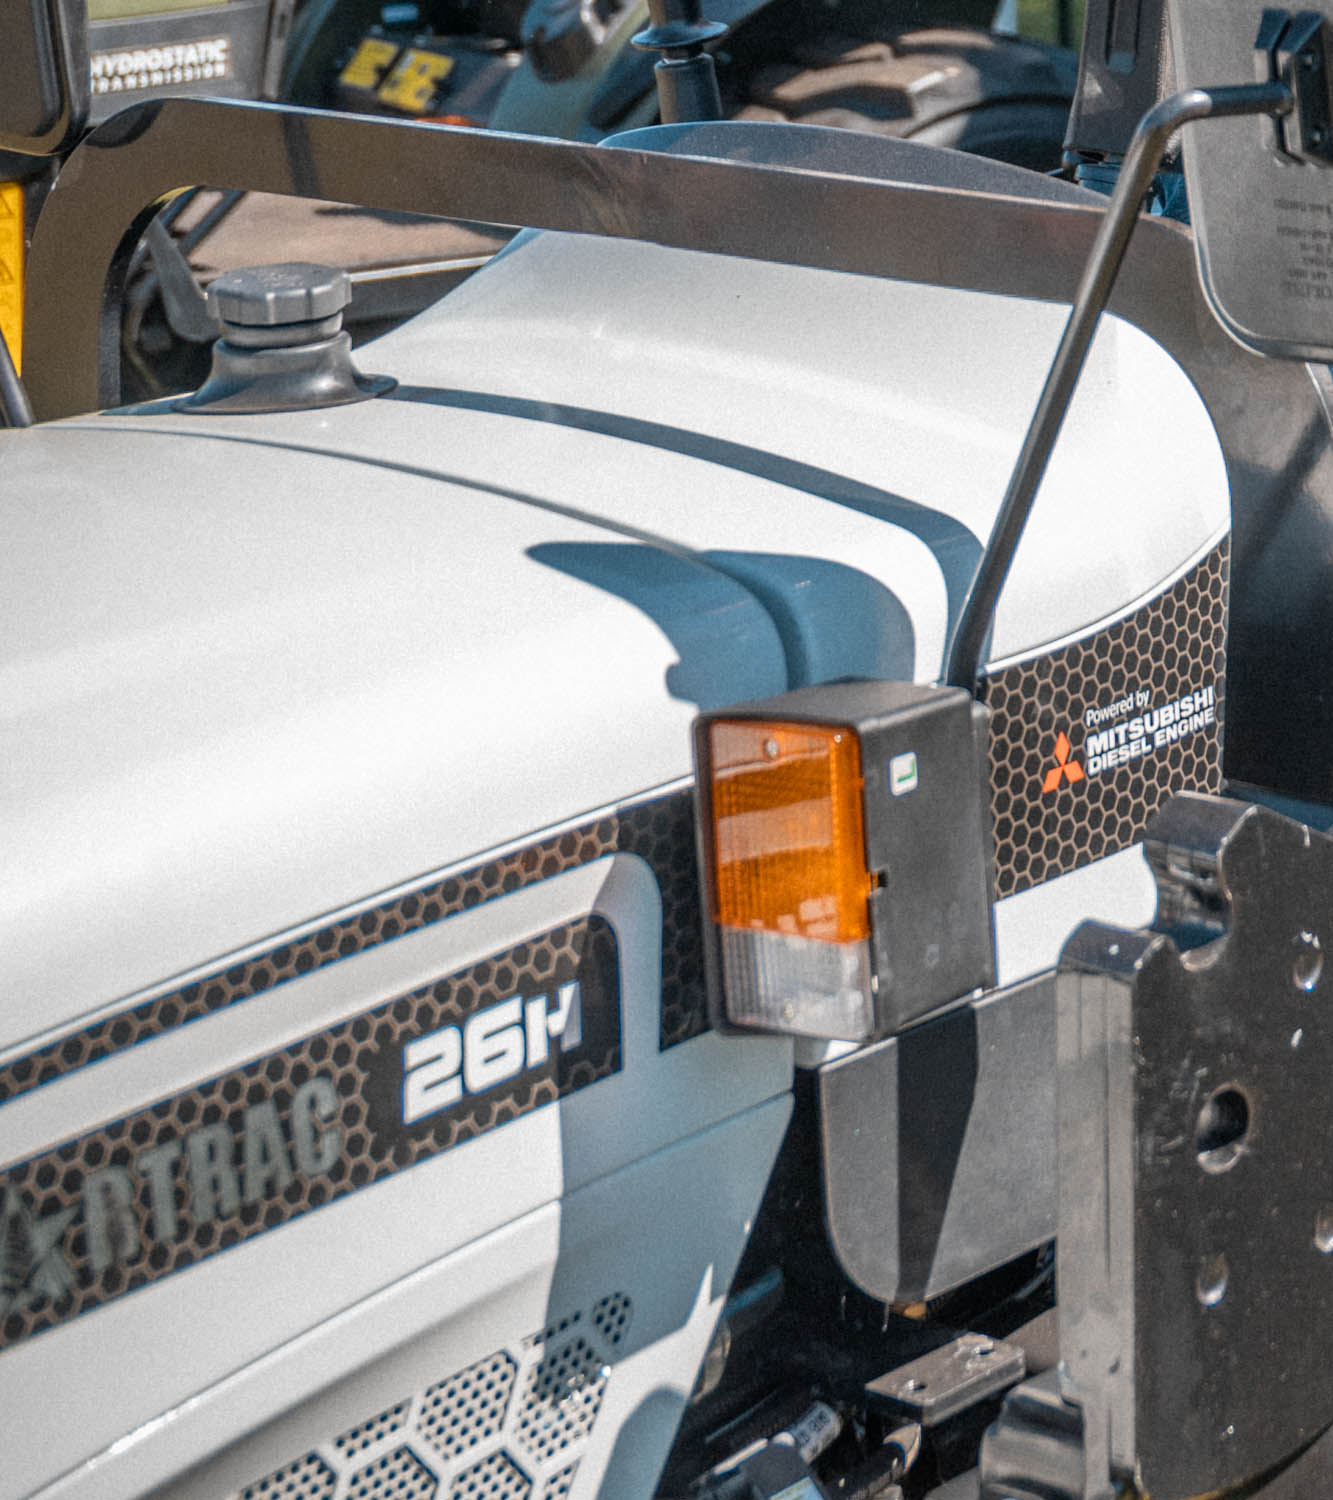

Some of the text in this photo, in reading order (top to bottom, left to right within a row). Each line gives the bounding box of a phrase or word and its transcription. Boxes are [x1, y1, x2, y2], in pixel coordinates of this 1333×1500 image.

[1086, 689, 1150, 727] Powered by
[1086, 685, 1214, 758] MITSUBISHI
[1087, 706, 1216, 777] DIESEL ENGINE
